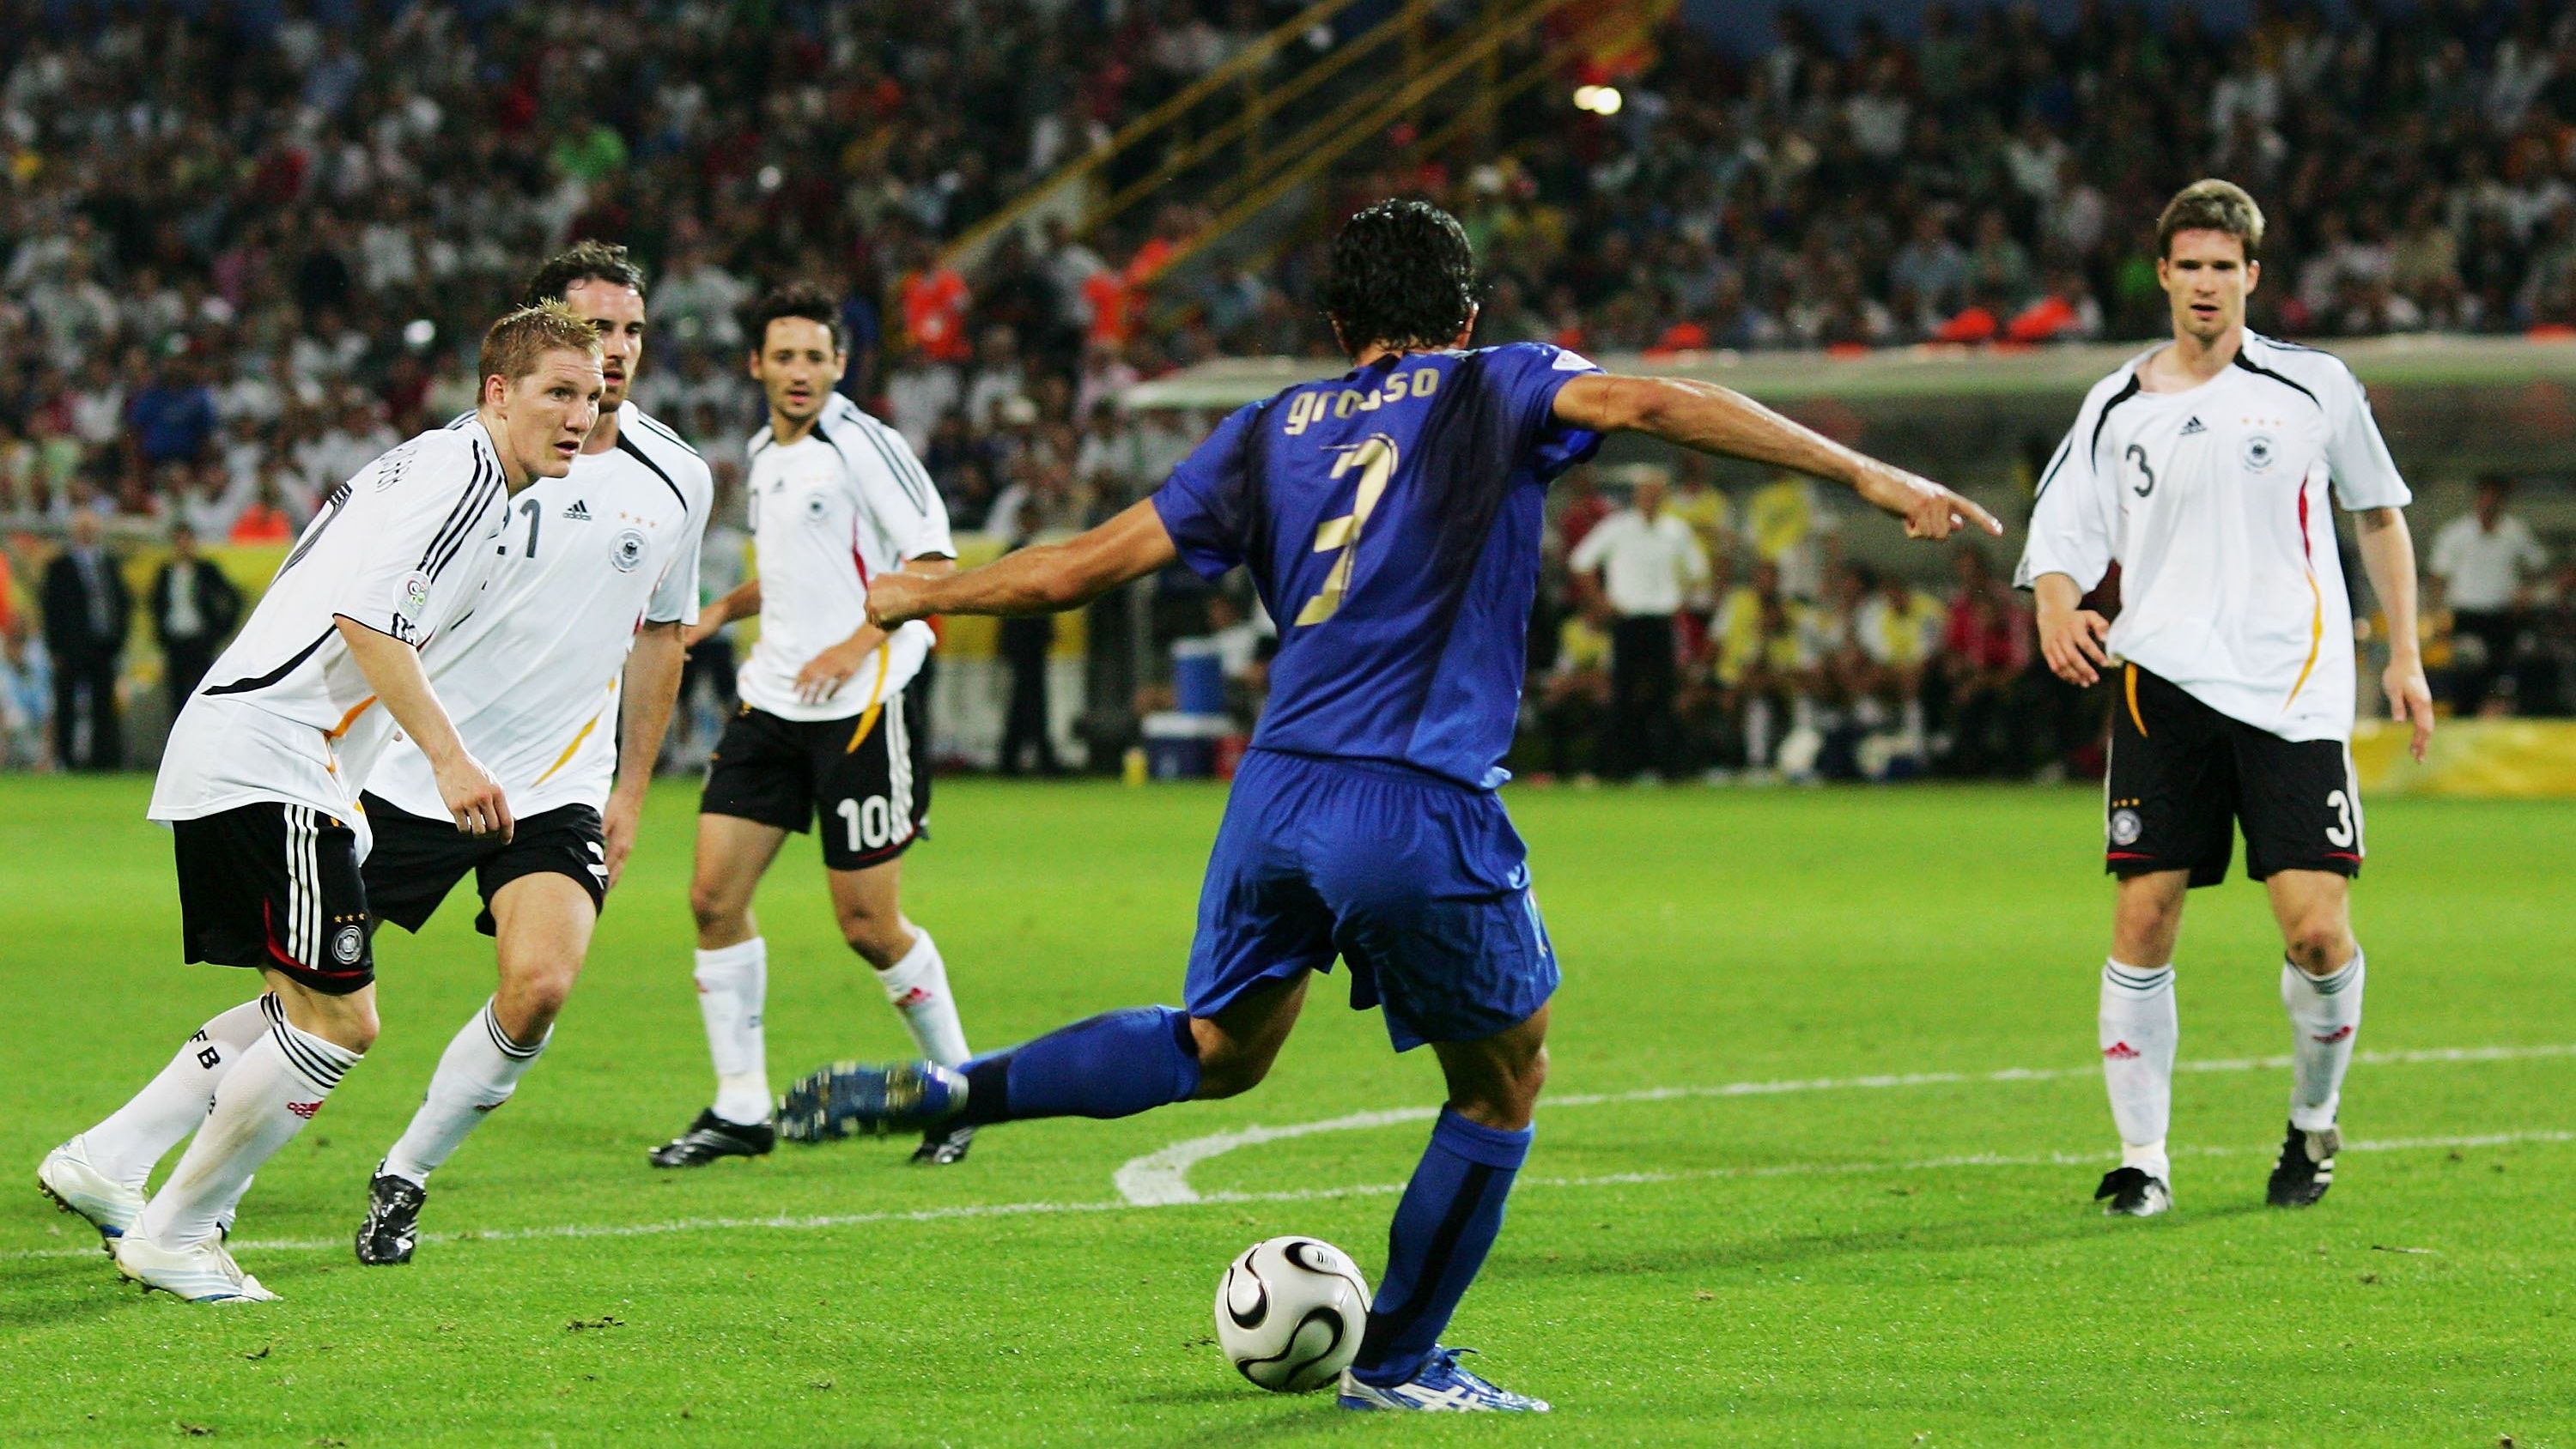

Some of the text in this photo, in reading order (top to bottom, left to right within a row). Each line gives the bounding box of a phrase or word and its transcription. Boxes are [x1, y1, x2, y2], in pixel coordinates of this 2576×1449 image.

[2125, 444, 2154, 498] 3
[1295, 433, 1399, 627] 3
[836, 794, 890, 852] 10
[2325, 789, 2354, 848] 3
